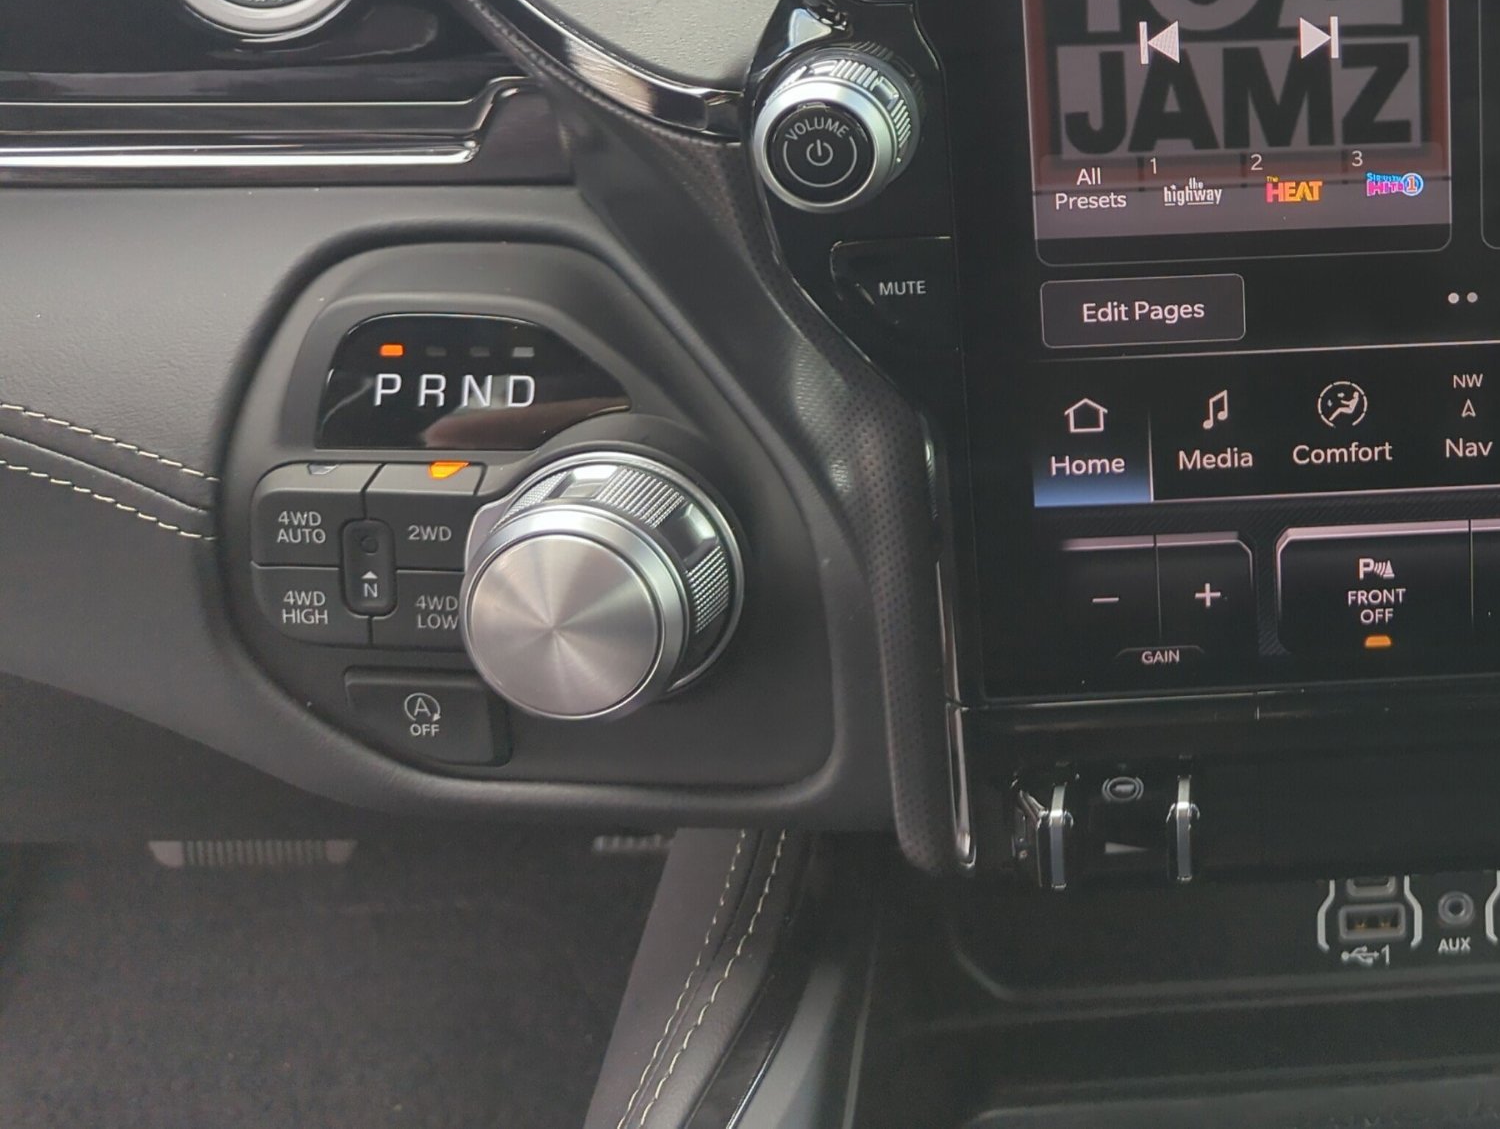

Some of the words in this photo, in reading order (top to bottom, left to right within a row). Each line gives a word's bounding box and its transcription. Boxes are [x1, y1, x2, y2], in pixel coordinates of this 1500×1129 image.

[1064, 41, 1413, 155] JAMZ
[785, 116, 851, 142] VOLUME
[1150, 157, 1157, 175] 1
[1250, 153, 1263, 171] 2
[1351, 149, 1364, 167] 3
[1076, 167, 1102, 186] All
[1055, 191, 1127, 211] Presets
[1163, 184, 1223, 206] highway
[1265, 180, 1324, 204] HEAT
[878, 279, 927, 296] MUTE
[1082, 301, 1129, 324] Edit
[1133, 299, 1205, 325] Pages
[373, 373, 402, 406] P
[417, 373, 447, 407] R
[461, 374, 493, 408] N
[506, 374, 536, 408] D
[1452, 373, 1484, 390] NW
[1292, 440, 1393, 466] Comfort
[1445, 437, 1494, 459] Nav
[1049, 453, 1125, 477] Home
[1178, 446, 1254, 471] Media
[278, 510, 322, 528] 4WD
[276, 527, 327, 545] AUTO
[407, 524, 452, 543] 2WD
[283, 590, 326, 607] 4WD
[363, 582, 379, 599] N
[1347, 587, 1407, 607] FRONT
[415, 594, 459, 612] 4WD
[281, 607, 329, 626] HIGH
[416, 613, 459, 631] LOW
[1360, 608, 1394, 625] OFF
[1141, 648, 1181, 664] GAIN
[409, 723, 440, 738] OFF
[1380, 945, 1391, 965] 1
[1437, 937, 1472, 954] AUX
